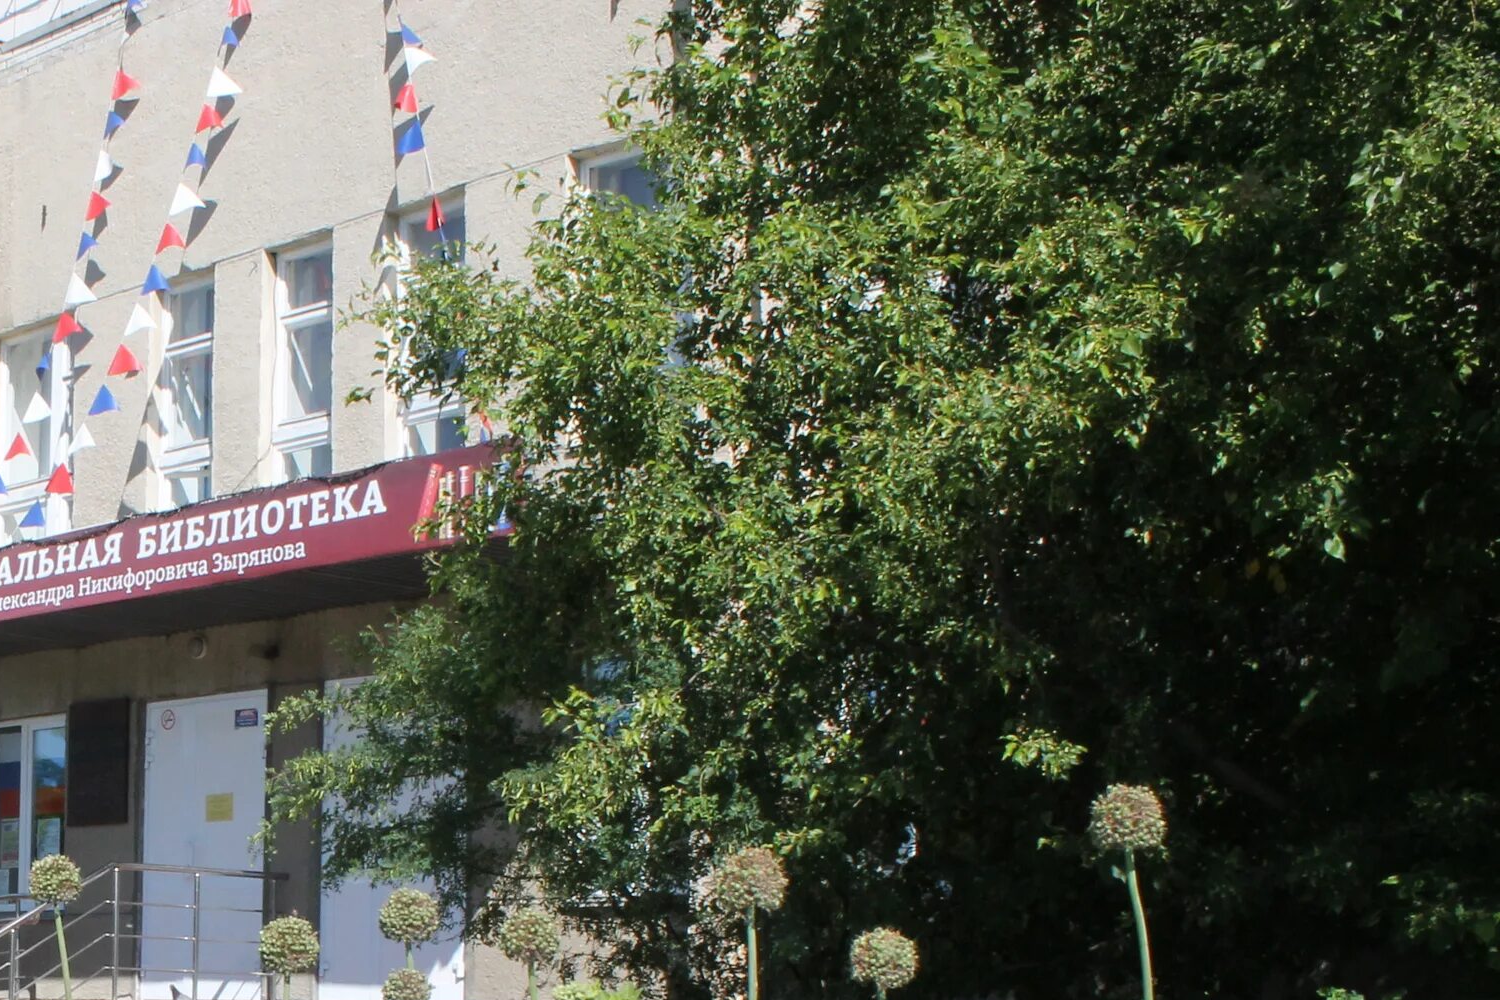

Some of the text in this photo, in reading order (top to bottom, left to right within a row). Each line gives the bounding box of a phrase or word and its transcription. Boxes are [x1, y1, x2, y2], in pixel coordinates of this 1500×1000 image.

[136, 479, 387, 559] БИБЛИОТЕКА
[77, 558, 208, 597] Никифоровича
[211, 541, 306, 577] Зырянова
